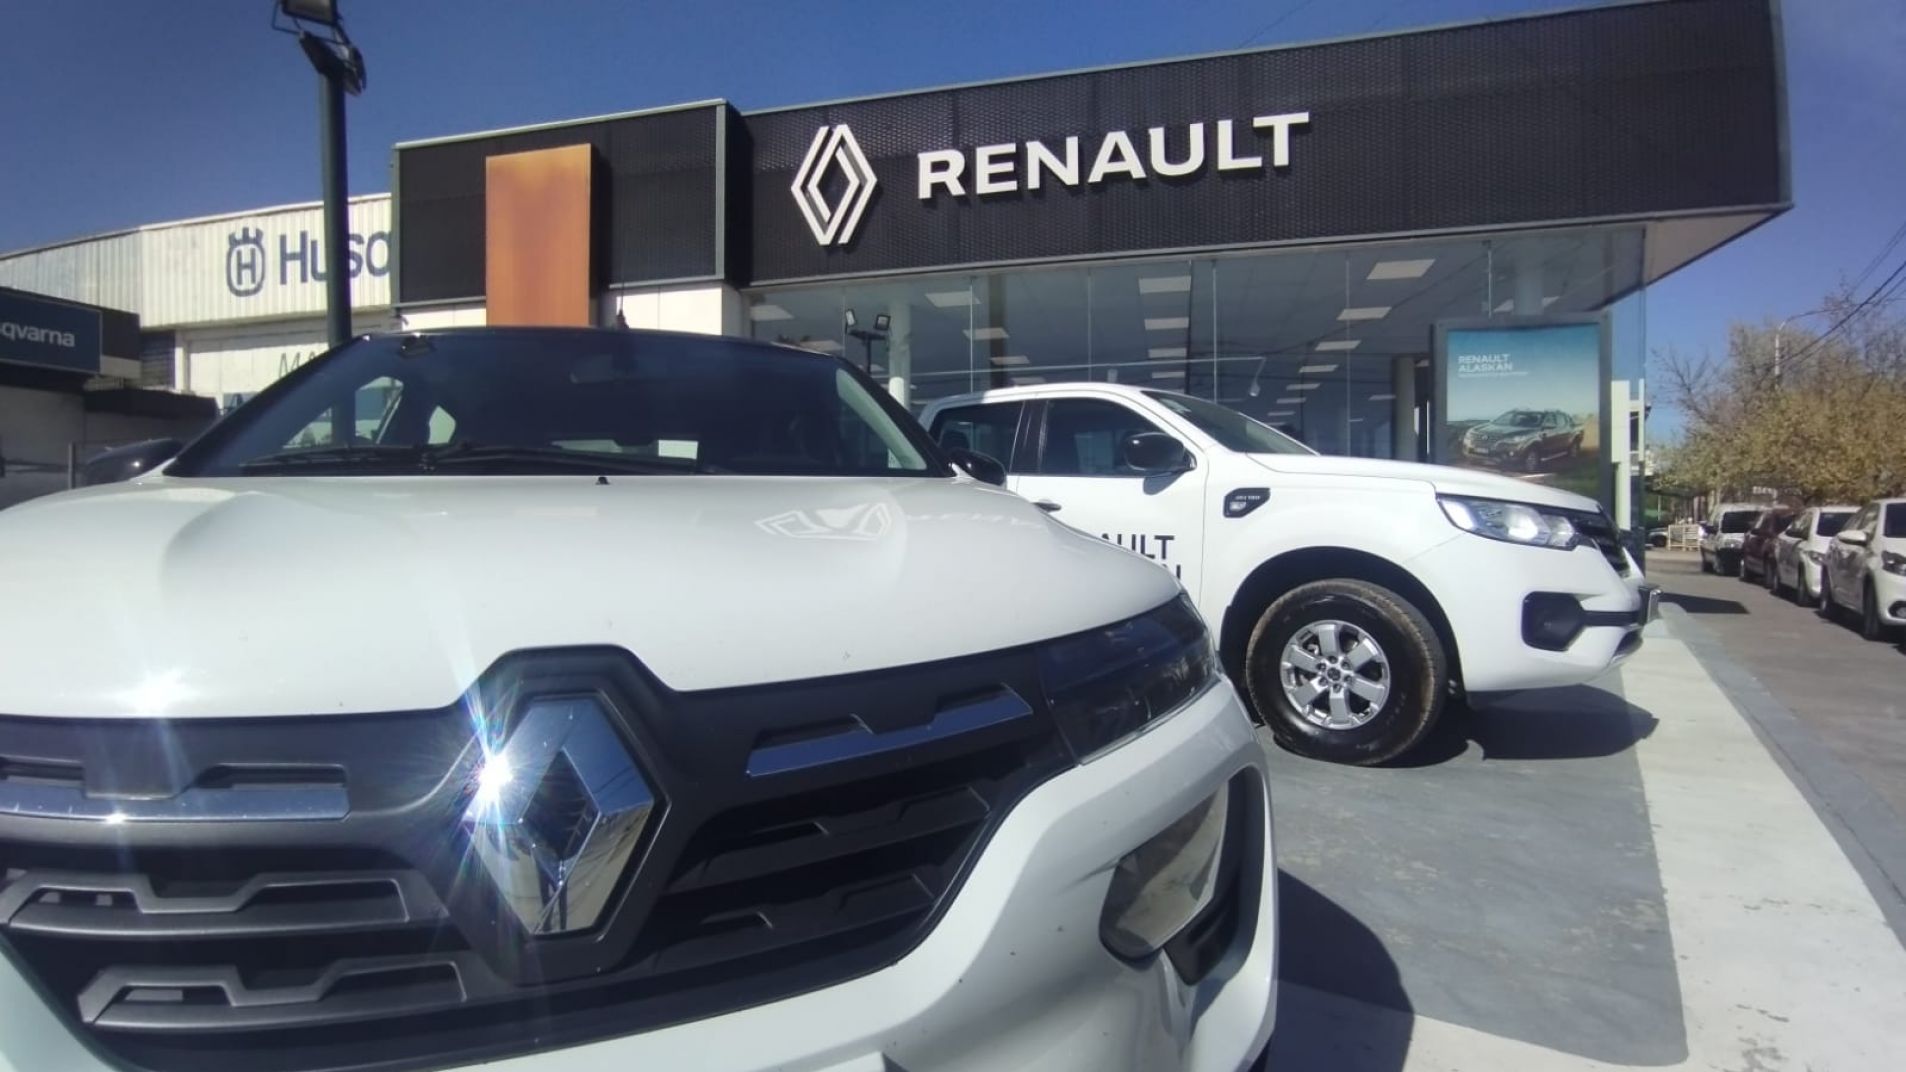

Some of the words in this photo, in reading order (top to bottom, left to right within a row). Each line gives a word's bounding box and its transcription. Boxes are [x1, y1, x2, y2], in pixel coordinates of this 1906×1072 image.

[917, 112, 1310, 200] RENAULT
[0, 321, 76, 348] qvarna
[1458, 353, 1511, 364] RENAULT
[1458, 362, 1513, 373] ALASKAN
